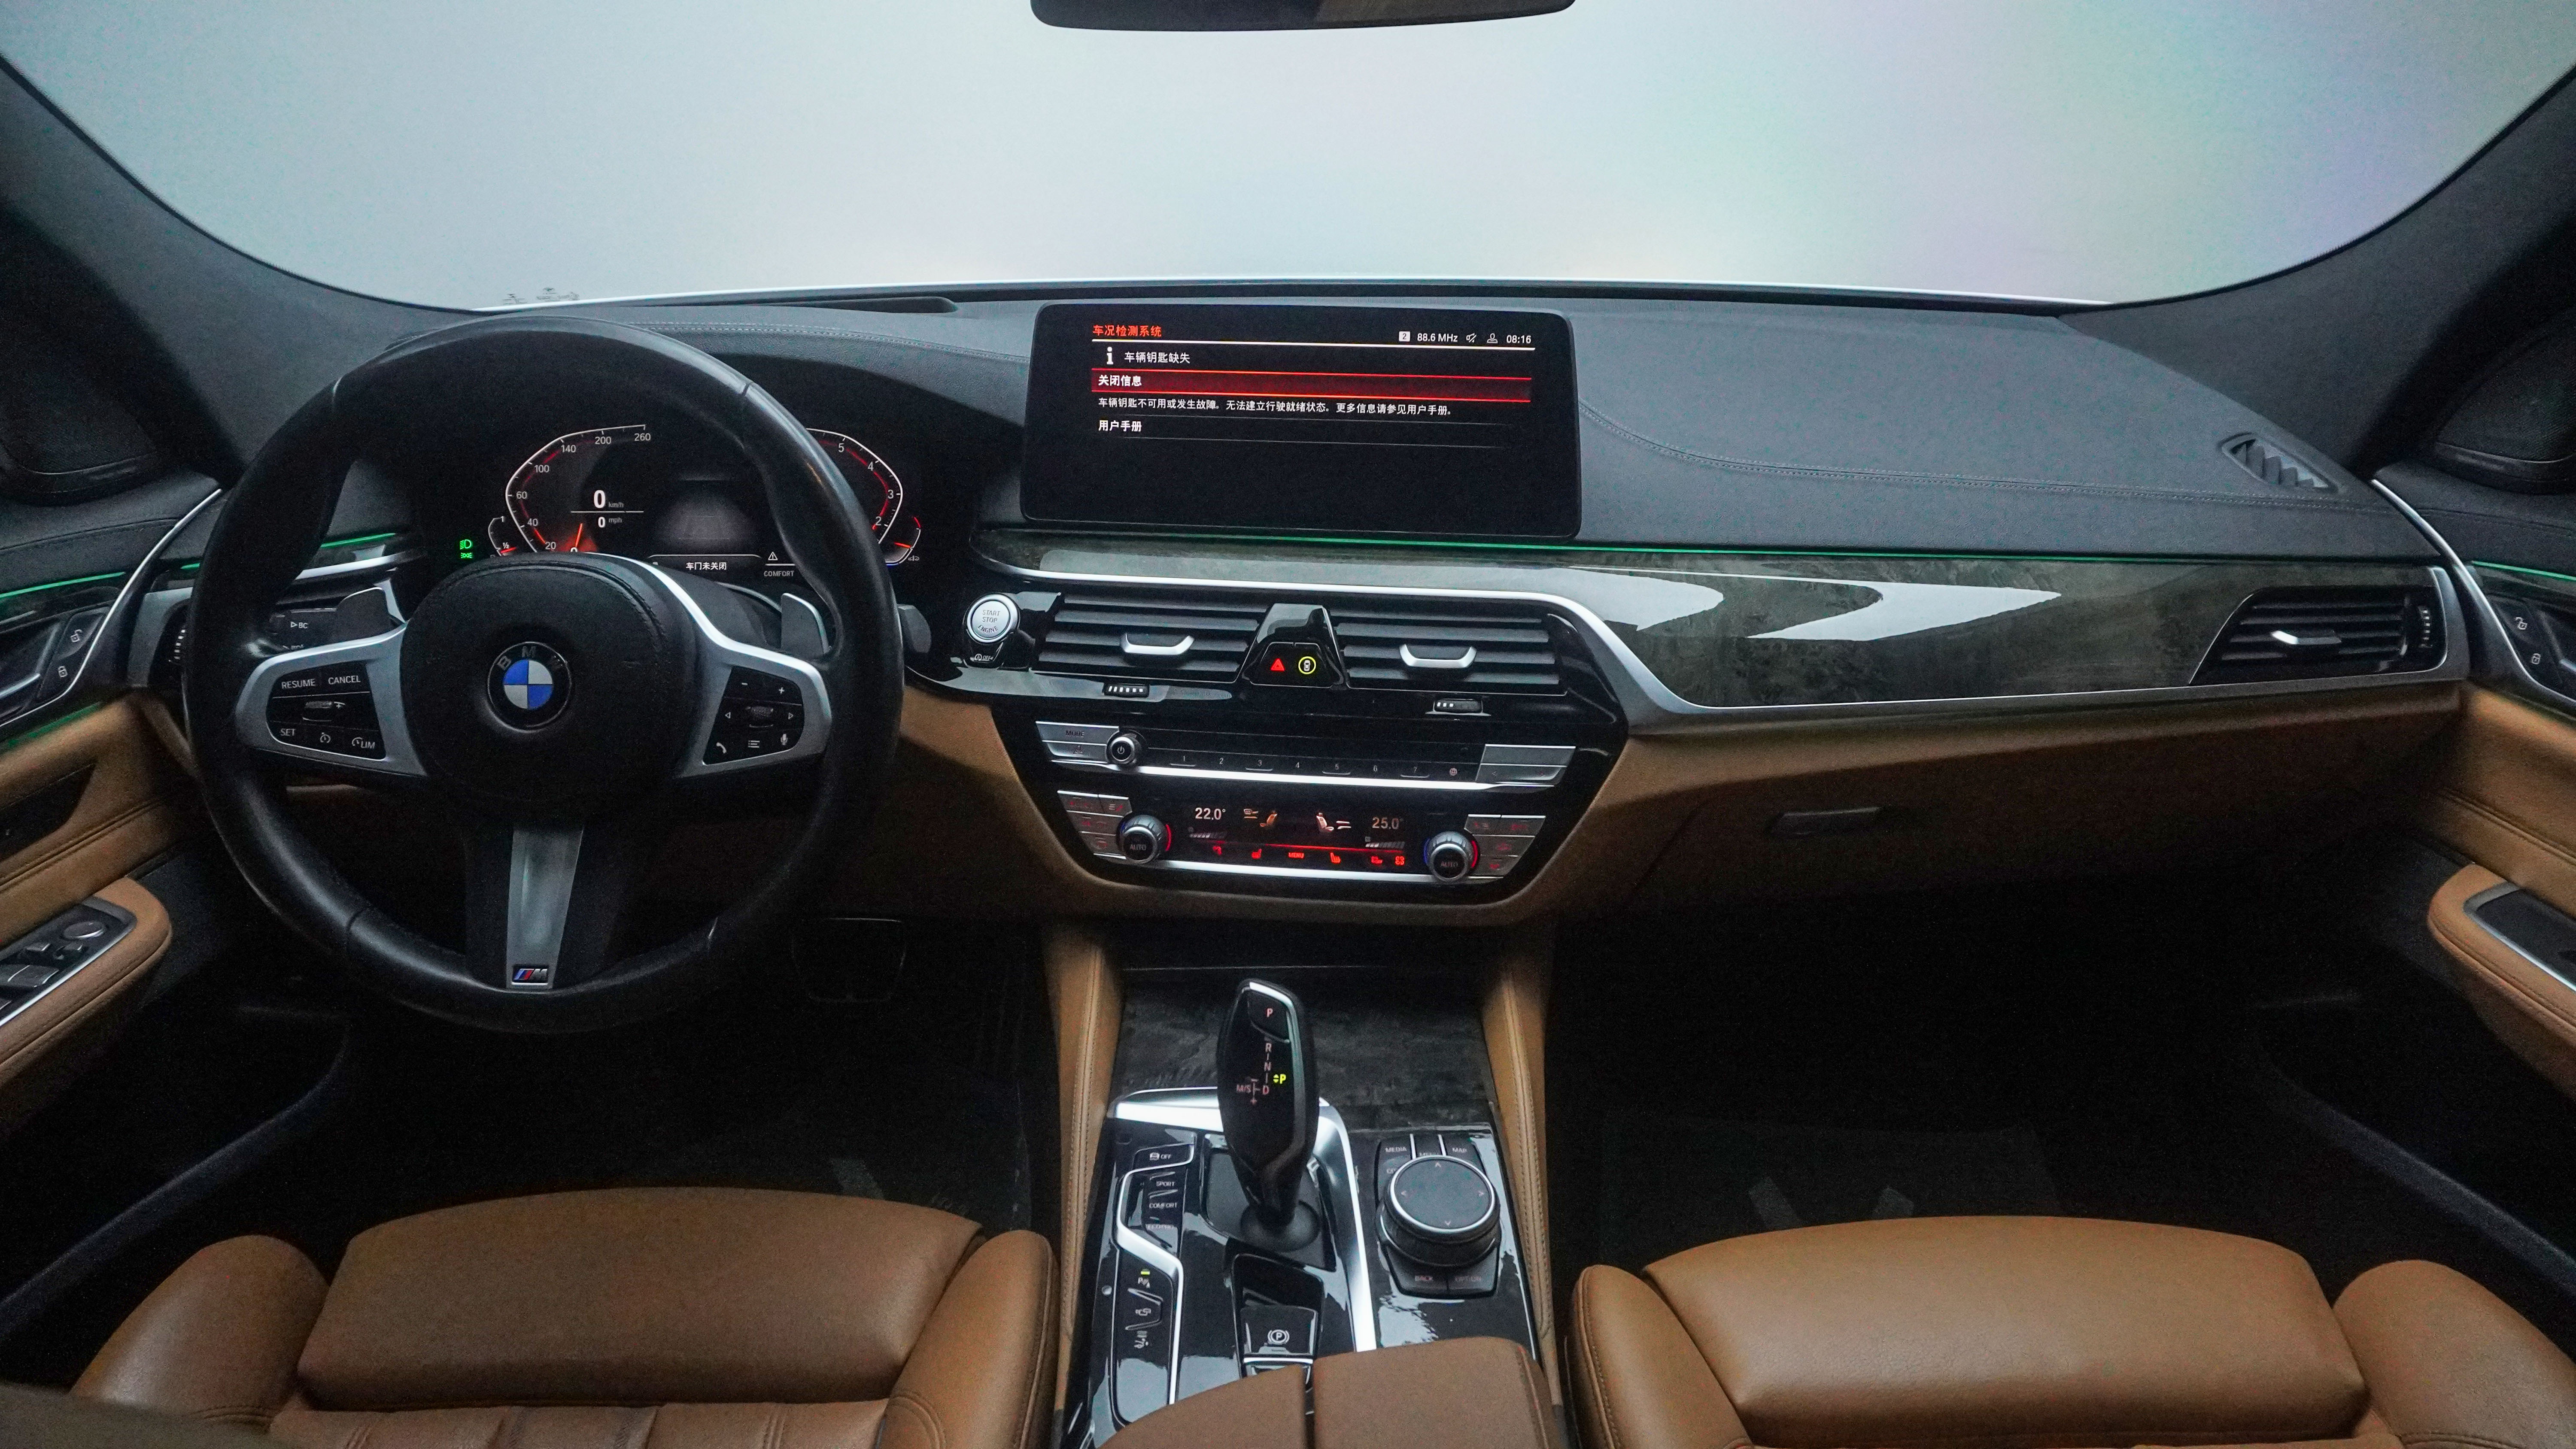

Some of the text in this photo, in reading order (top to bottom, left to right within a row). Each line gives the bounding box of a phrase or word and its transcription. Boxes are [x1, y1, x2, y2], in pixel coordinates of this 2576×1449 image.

[1092, 324, 1162, 337] 车况检测系统
[1417, 333, 1458, 342] 88.6 MHz
[1507, 335, 1531, 344] 08:16
[1124, 351, 1190, 364] 车辆钥匙缺失
[1098, 374, 1142, 387] 关闭信息
[1098, 420, 1142, 432] 用户手册
[595, 436, 611, 445] 200
[634, 433, 651, 441] 260
[561, 444, 576, 453] 140
[838, 443, 844, 452] 5
[535, 464, 550, 473] 100
[867, 461, 874, 471] 4
[516, 491, 527, 499] 60
[887, 489, 894, 499] 3
[593, 490, 606, 509] 0
[527, 518, 538, 527] 40
[598, 516, 606, 528] 0
[875, 516, 881, 525] 2
[545, 541, 556, 550] 20
[685, 562, 727, 571] 车门未关闭
[978, 624, 998, 633] ENGINE
[281, 675, 361, 690] RESUME CANCEL
[280, 728, 296, 737] SET
[360, 740, 376, 749] LIM
[1266, 1007, 1273, 1018] P
[1265, 1042, 1272, 1052] R
[1264, 1061, 1271, 1072] N
[1279, 1073, 1286, 1084] P
[1262, 1085, 1270, 1095] D
